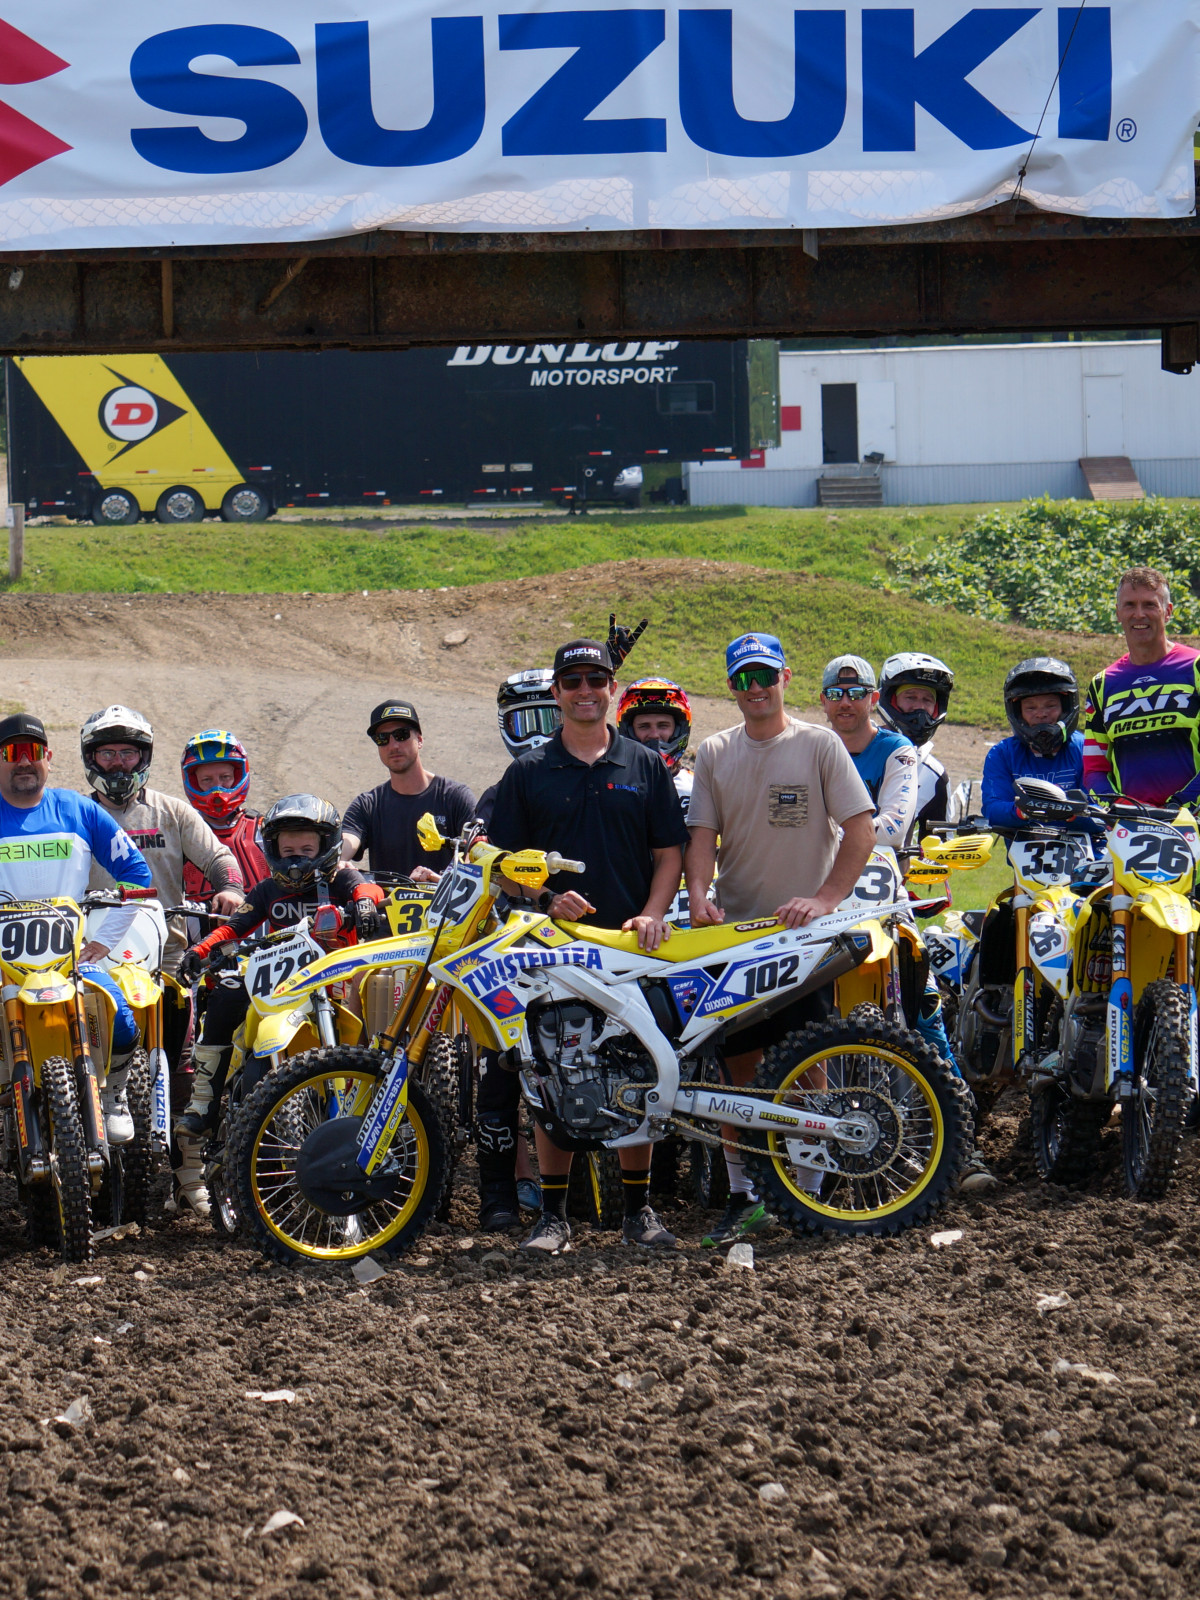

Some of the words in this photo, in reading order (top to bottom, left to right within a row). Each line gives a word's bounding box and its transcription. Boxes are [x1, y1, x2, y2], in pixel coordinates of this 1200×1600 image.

[130, 8, 1112, 174] SUZUKI
[530, 367, 678, 387] MOTORSPORT
[111, 403, 154, 426] D
[564, 648, 601, 659] SUZUKI
[1104, 684, 1195, 723] FXR
[1114, 715, 1177, 735] MOTO
[1026, 800, 1073, 812] ACERBIS
[1125, 834, 1191, 874] 26
[820, 913, 866, 927] DUNLOP
[2, 917, 73, 962] 900
[255, 951, 278, 963] TIMMY
[278, 941, 307, 955] GAUNTT
[371, 948, 427, 962] PROGRESSIVE
[462, 950, 557, 998] TWISTED
[561, 947, 604, 970] TEA
[744, 954, 799, 998] 102
[704, 995, 734, 1013] DIXXON
[1026, 977, 1035, 1042] DUNLOP
[1121, 1010, 1130, 1064] ACERBIS
[863, 1038, 918, 1064] DUNLOP
[157, 1073, 167, 1130] SUZUKI
[356, 1077, 390, 1146] DUNLOP
[382, 1077, 403, 1122] ACERBIS
[708, 1097, 754, 1122] Mika
[760, 1113, 799, 1125] HINSON
[805, 1119, 827, 1130] DID
